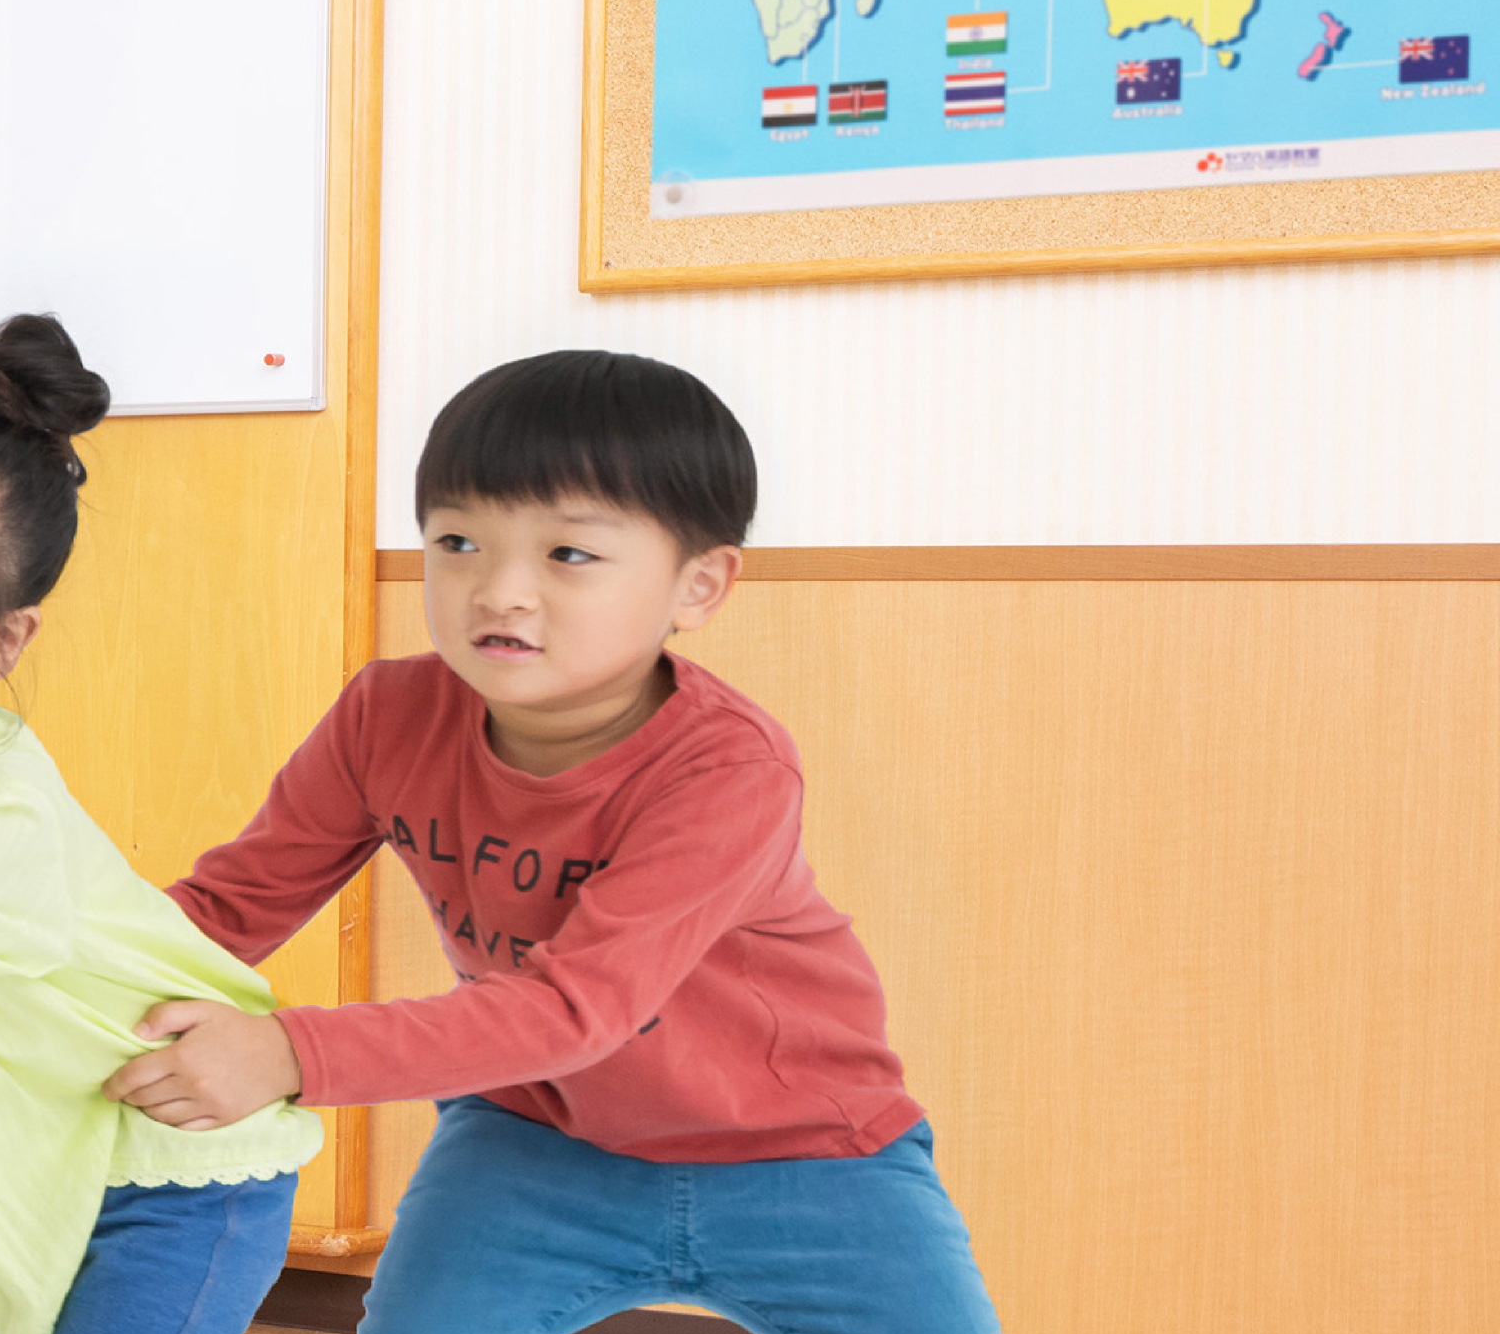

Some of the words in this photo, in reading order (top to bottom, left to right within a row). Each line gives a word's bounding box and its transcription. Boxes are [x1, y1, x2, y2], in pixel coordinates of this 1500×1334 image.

[957, 57, 992, 70] India
[1381, 87, 1414, 101] New
[1420, 81, 1486, 98] Zealand
[1112, 104, 1183, 119] Australia
[945, 116, 1005, 130] Thailand
[770, 129, 809, 143] Egypt
[835, 125, 879, 138] Kenya
